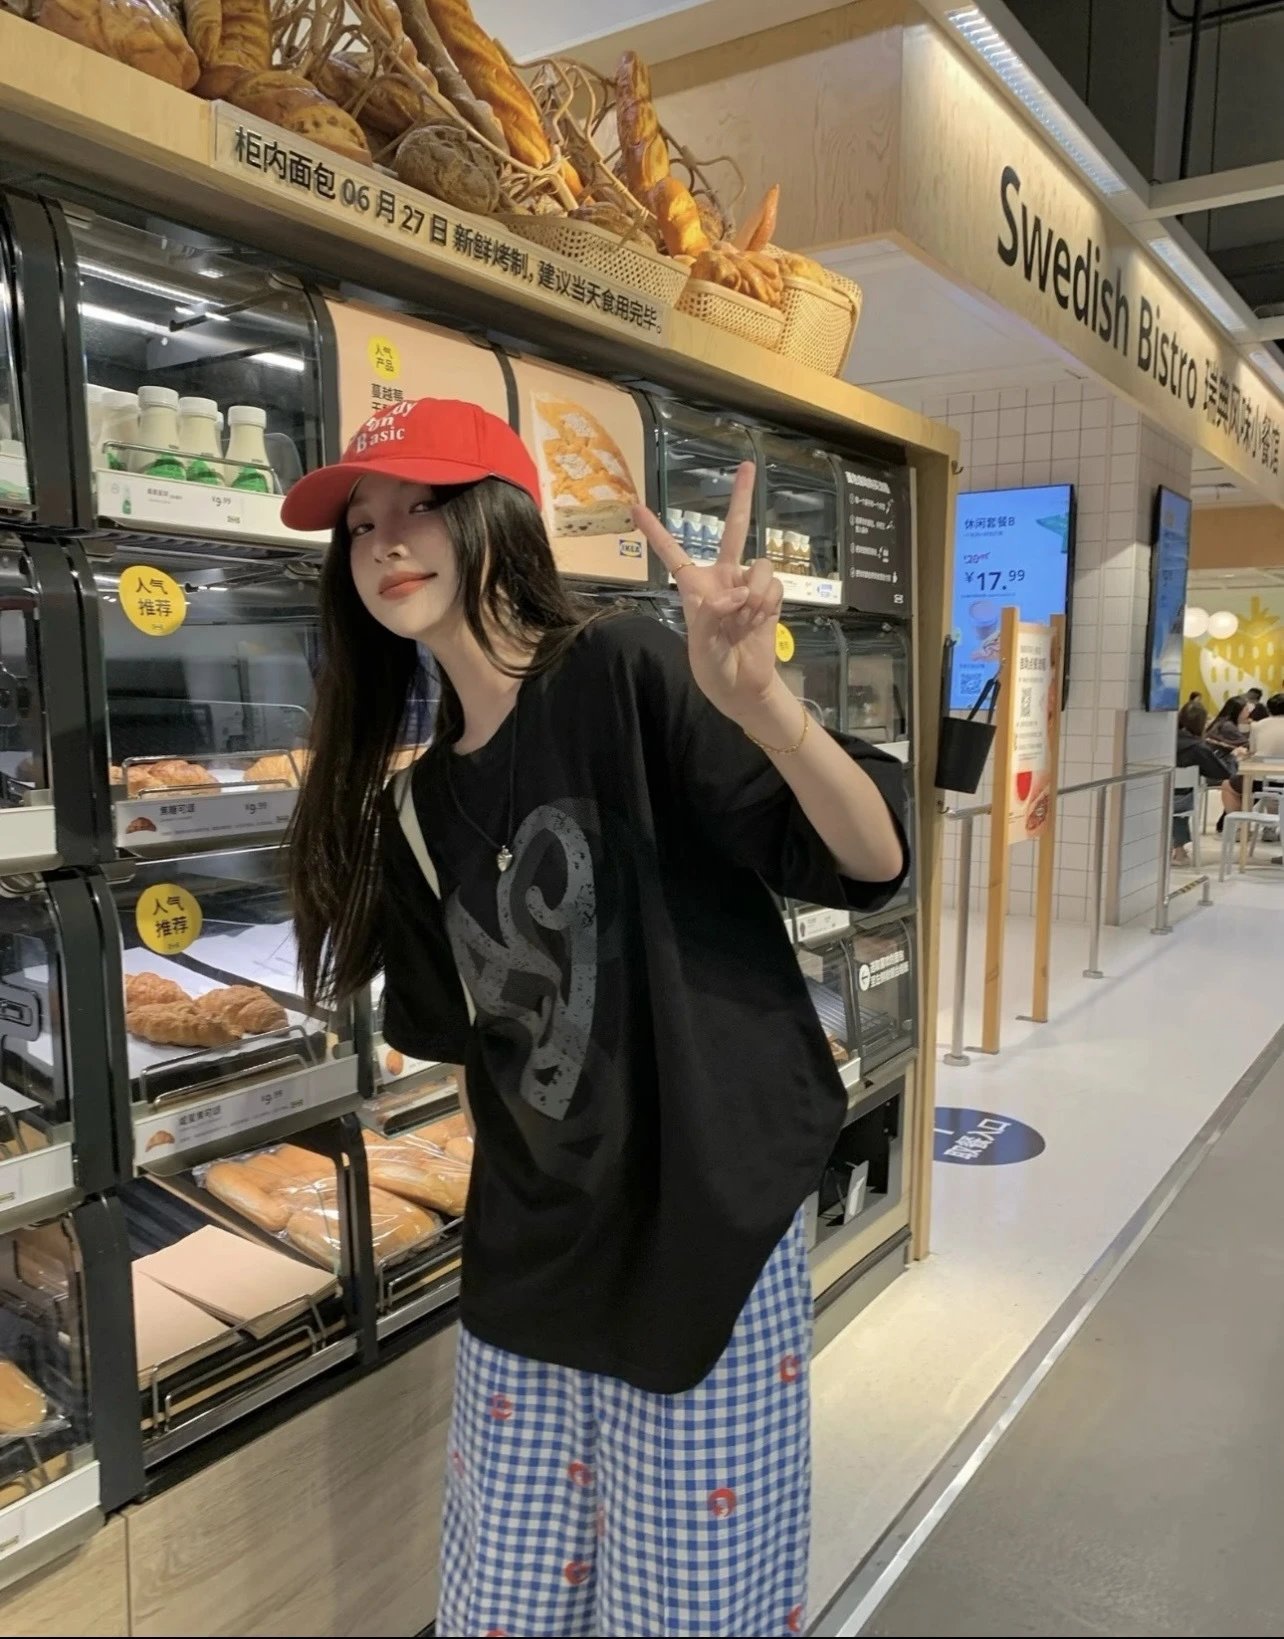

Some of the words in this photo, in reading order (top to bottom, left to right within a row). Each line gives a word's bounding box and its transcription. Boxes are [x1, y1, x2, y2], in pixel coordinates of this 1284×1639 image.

[235, 126, 336, 200] 柜内面包
[341, 178, 370, 211] 06
[376, 190, 395, 225] 月
[401, 207, 425, 235] 27
[430, 214, 448, 246] 日
[997, 165, 1130, 356] Swedish
[1137, 295, 1198, 409] Bistro
[356, 426, 406, 453] Basic
[135, 577, 168, 595] 人气
[137, 598, 173, 617] 推荐
[153, 896, 185, 916] 人气
[155, 916, 189, 938] 推荐
